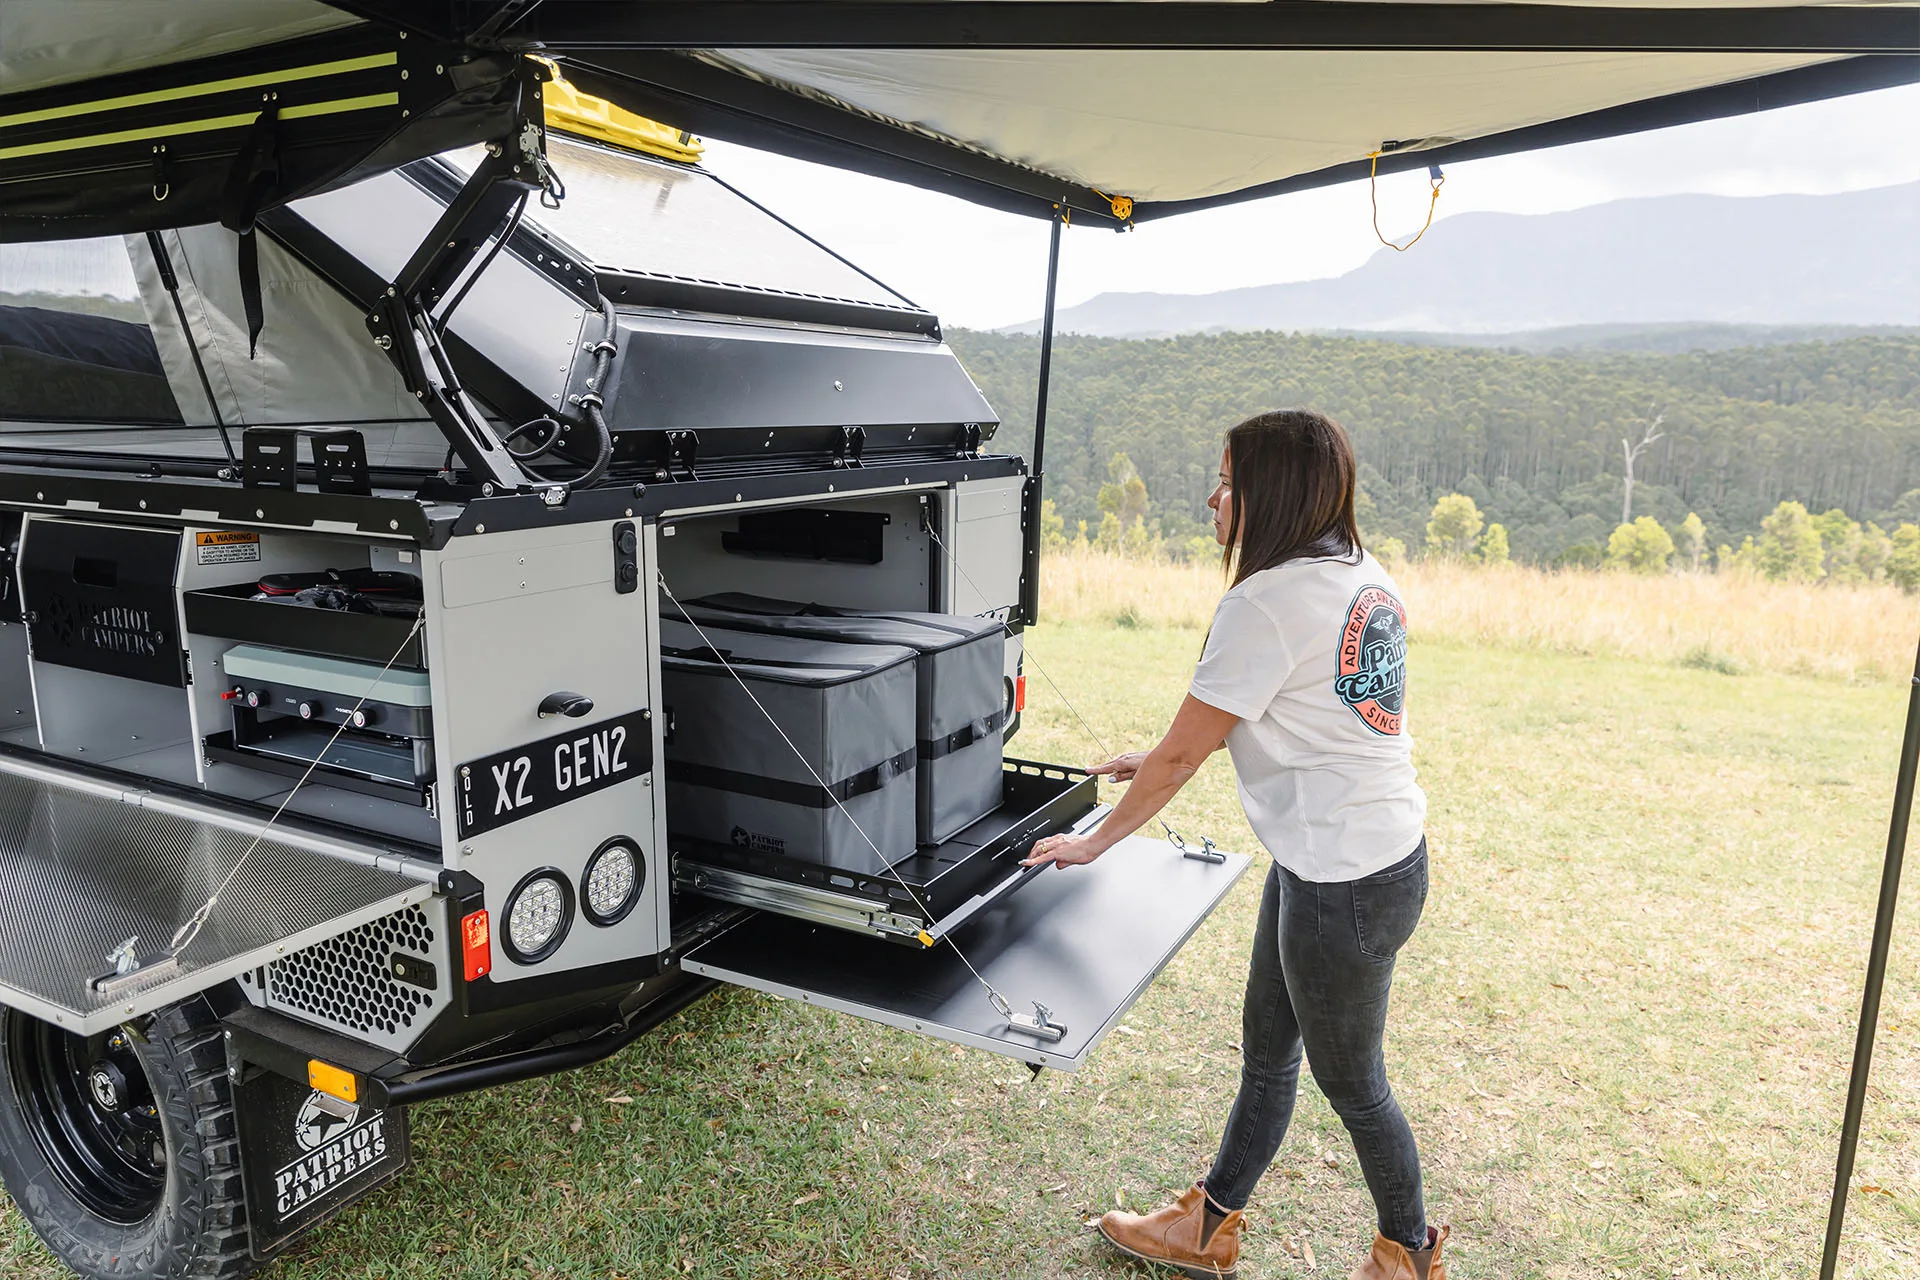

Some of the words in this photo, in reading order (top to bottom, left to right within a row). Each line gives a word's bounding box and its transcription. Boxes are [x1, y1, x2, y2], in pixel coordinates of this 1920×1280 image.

[216, 533, 252, 542] WARNING
[1345, 592, 1376, 667] ADVENTURE
[1366, 706, 1400, 731] SINCE
[463, 776, 474, 826] QLD
[491, 756, 534, 816] X2
[554, 725, 628, 792] GEN2
[751, 834, 785, 848] PATRIOT
[275, 1118, 384, 1197] PATRIOT
[277, 1137, 386, 1213] CAMPERS
